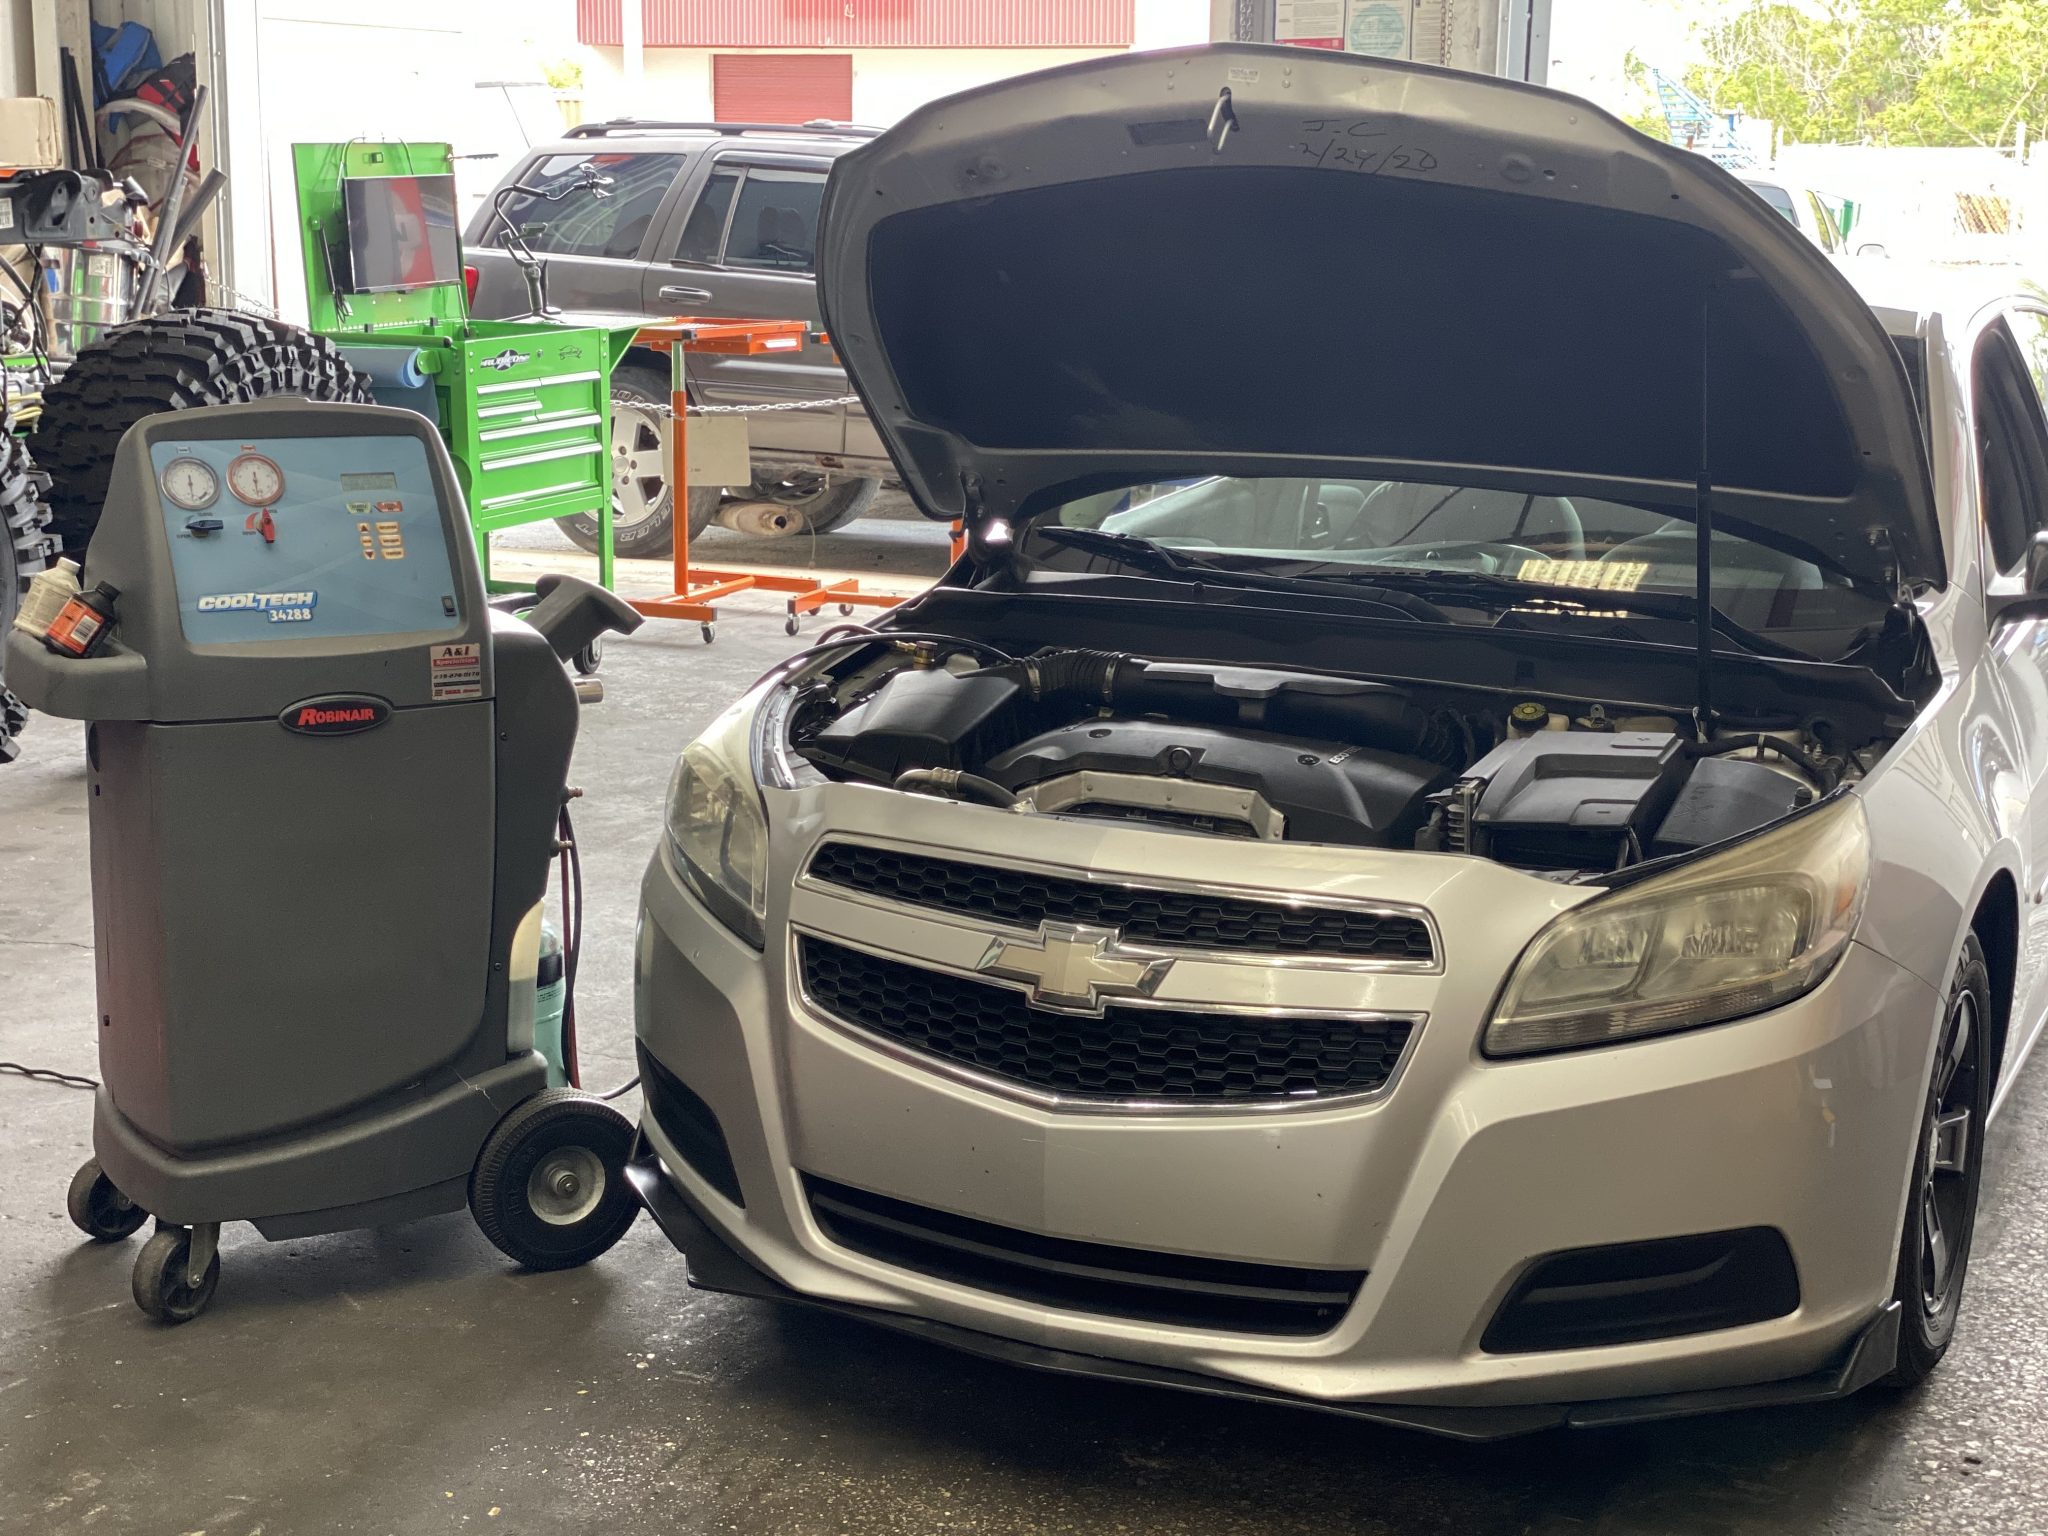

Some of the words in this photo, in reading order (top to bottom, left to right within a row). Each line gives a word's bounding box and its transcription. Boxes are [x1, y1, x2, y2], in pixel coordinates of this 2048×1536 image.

[198, 592, 314, 609] COOLTECH
[269, 608, 312, 622] 34288
[298, 708, 375, 726] ROBINAIR
